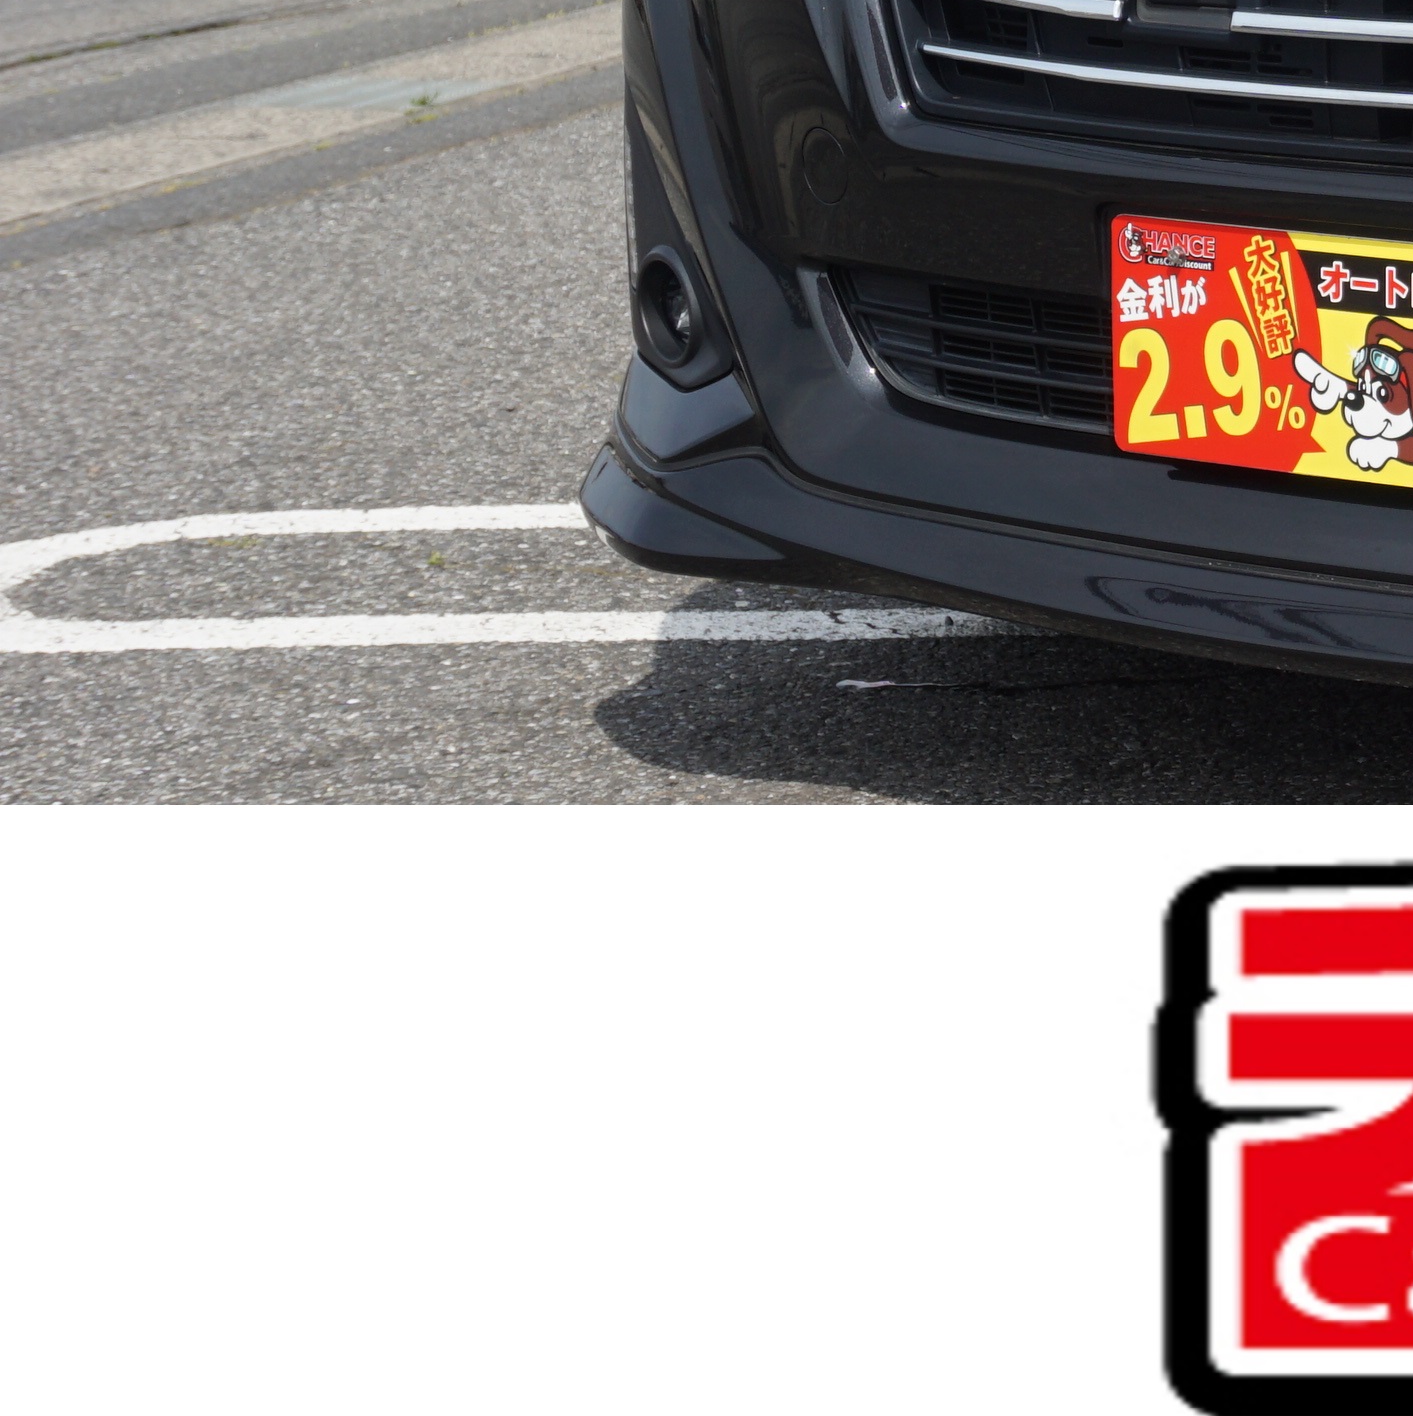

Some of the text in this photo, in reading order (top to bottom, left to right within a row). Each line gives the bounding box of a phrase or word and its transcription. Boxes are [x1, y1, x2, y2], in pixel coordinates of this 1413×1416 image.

[1117, 273, 1207, 322] 金利が
[1244, 234, 1295, 359] 大好評
